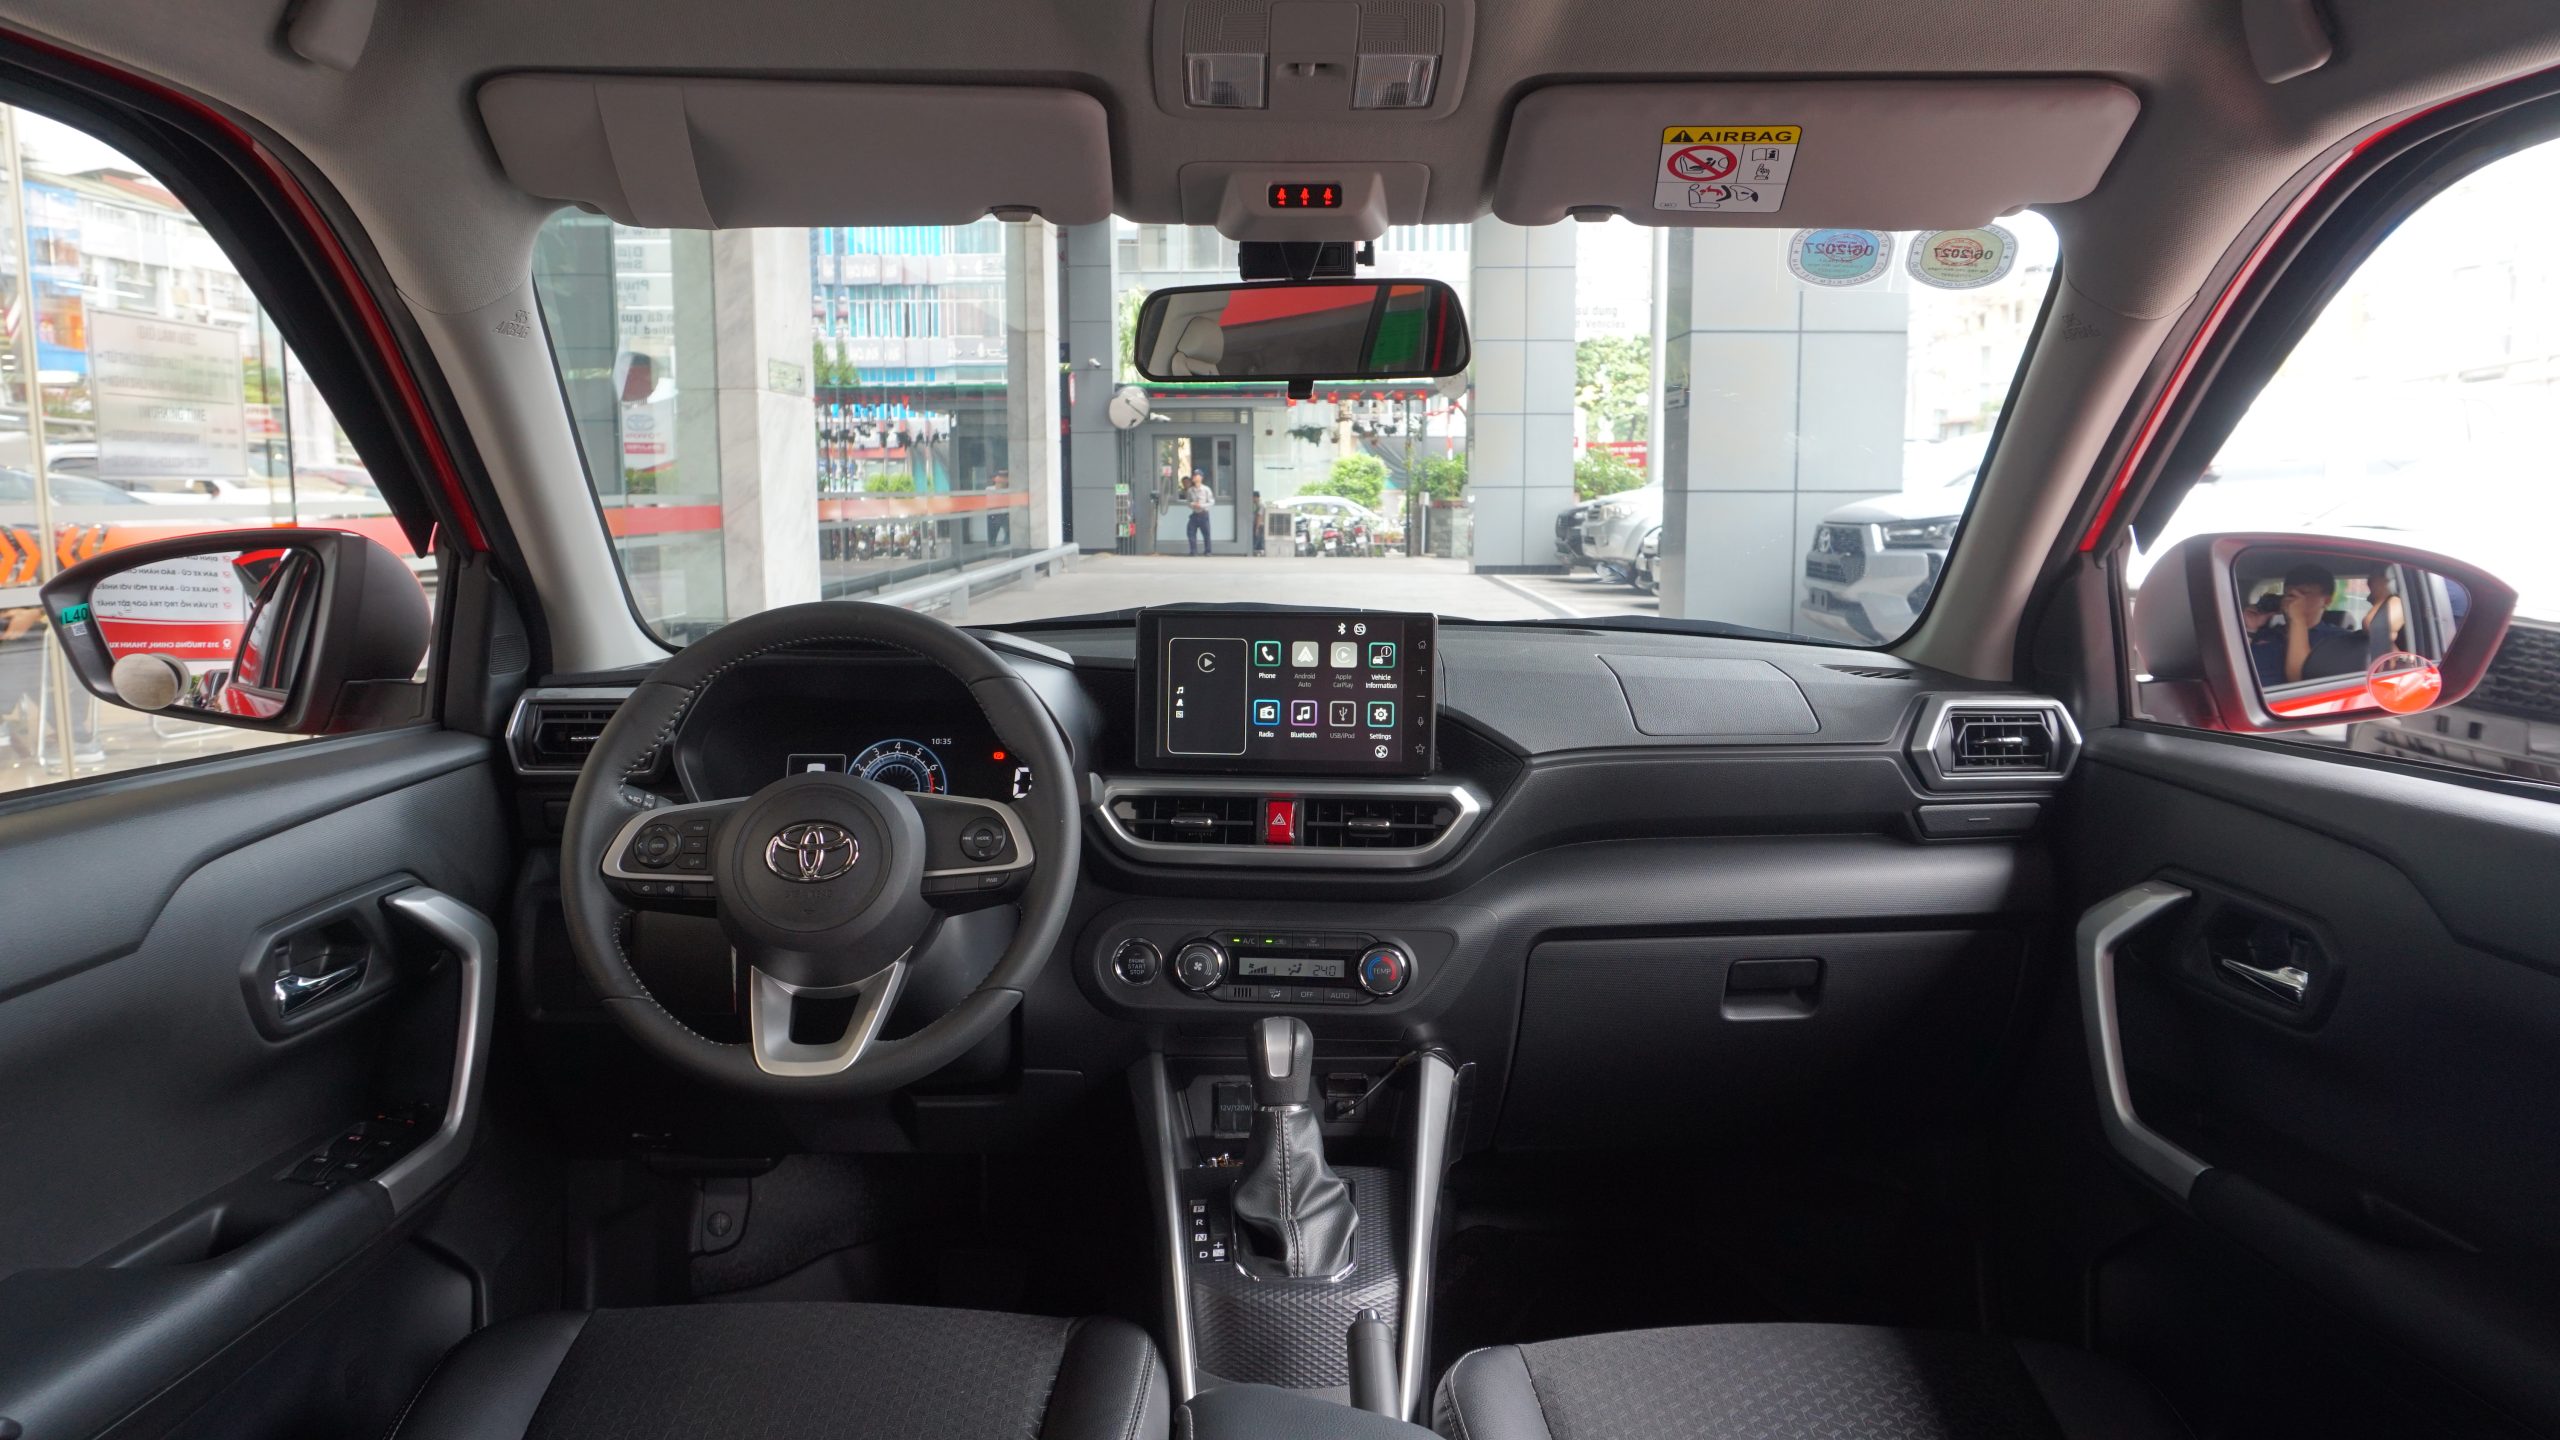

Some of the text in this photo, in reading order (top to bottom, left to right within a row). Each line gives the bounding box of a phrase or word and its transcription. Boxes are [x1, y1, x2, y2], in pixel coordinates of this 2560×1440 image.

[1698, 131, 1792, 142] AIRBAG
[64, 608, 88, 624] L40
[1335, 673, 1352, 681] Apple
[1369, 732, 1392, 741] Settings
[916, 748, 924, 756] 5
